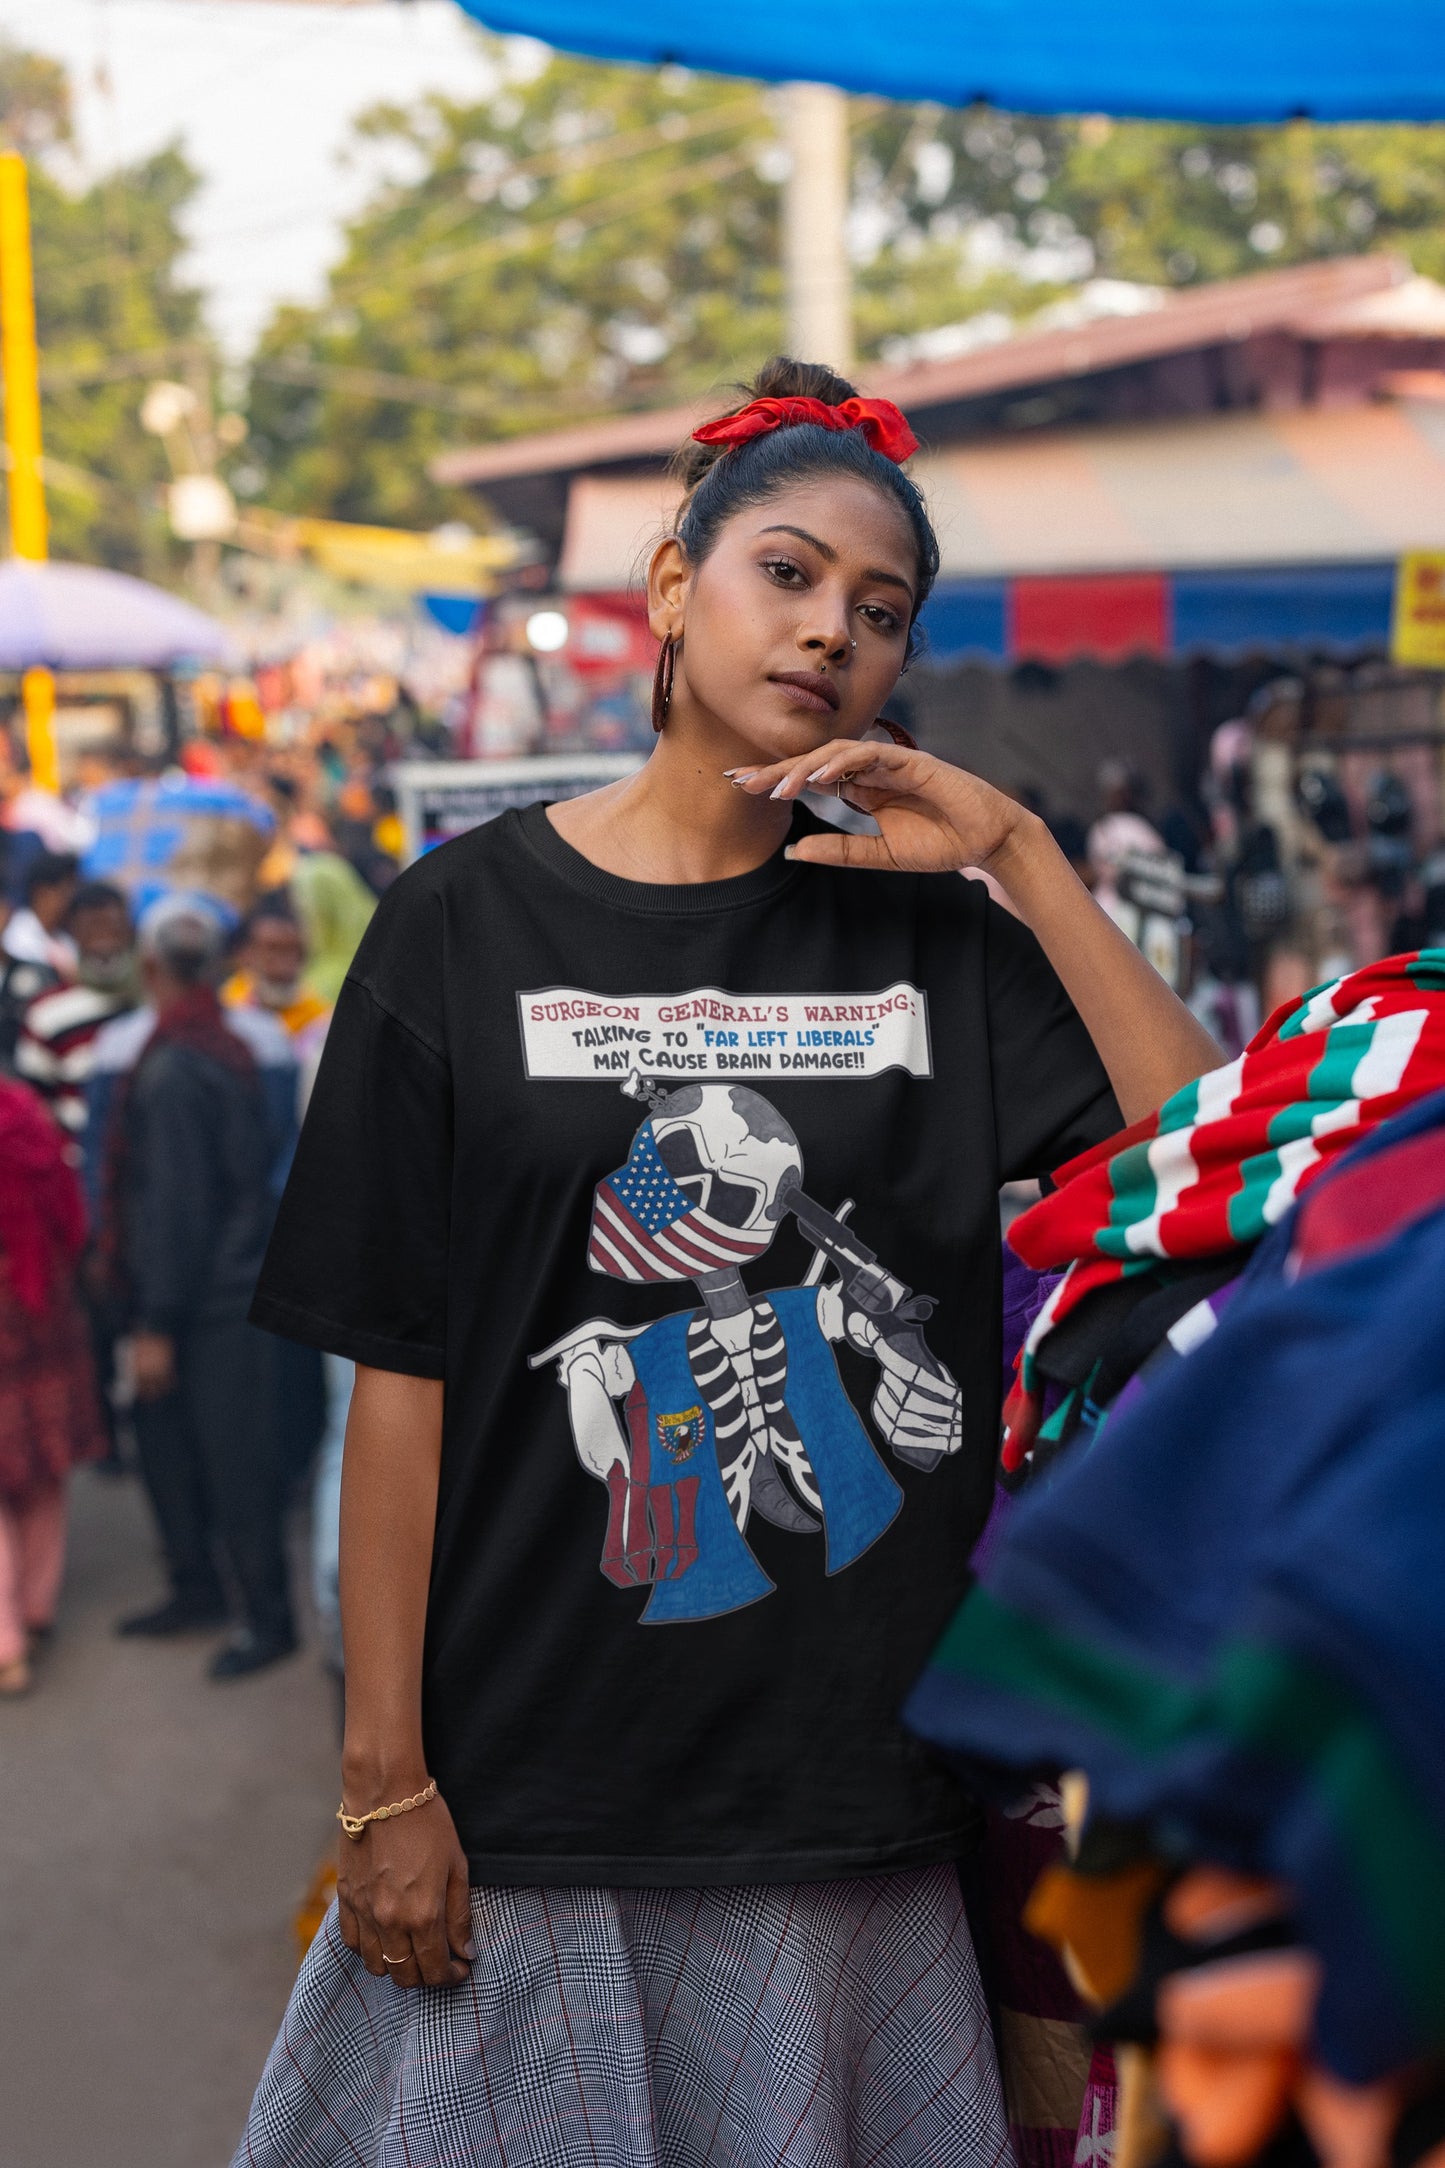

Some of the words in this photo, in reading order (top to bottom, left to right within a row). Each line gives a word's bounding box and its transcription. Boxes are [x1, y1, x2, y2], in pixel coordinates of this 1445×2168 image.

[531, 1000, 640, 1022] SURGEON
[658, 999, 789, 1023] GENERAL'S
[804, 994, 916, 1022] WARNING:
[572, 1025, 651, 1047] TALKING
[663, 1032, 688, 1047] TO
[697, 1023, 739, 1047] "FAR
[748, 1031, 788, 1047] LEFT
[797, 1023, 880, 1047] LIBERALS"
[594, 1050, 630, 1070] MAY
[639, 1048, 707, 1070] CAUSE
[716, 1053, 771, 1070] BRAIN
[780, 1052, 865, 1069] DAMAGE!!
